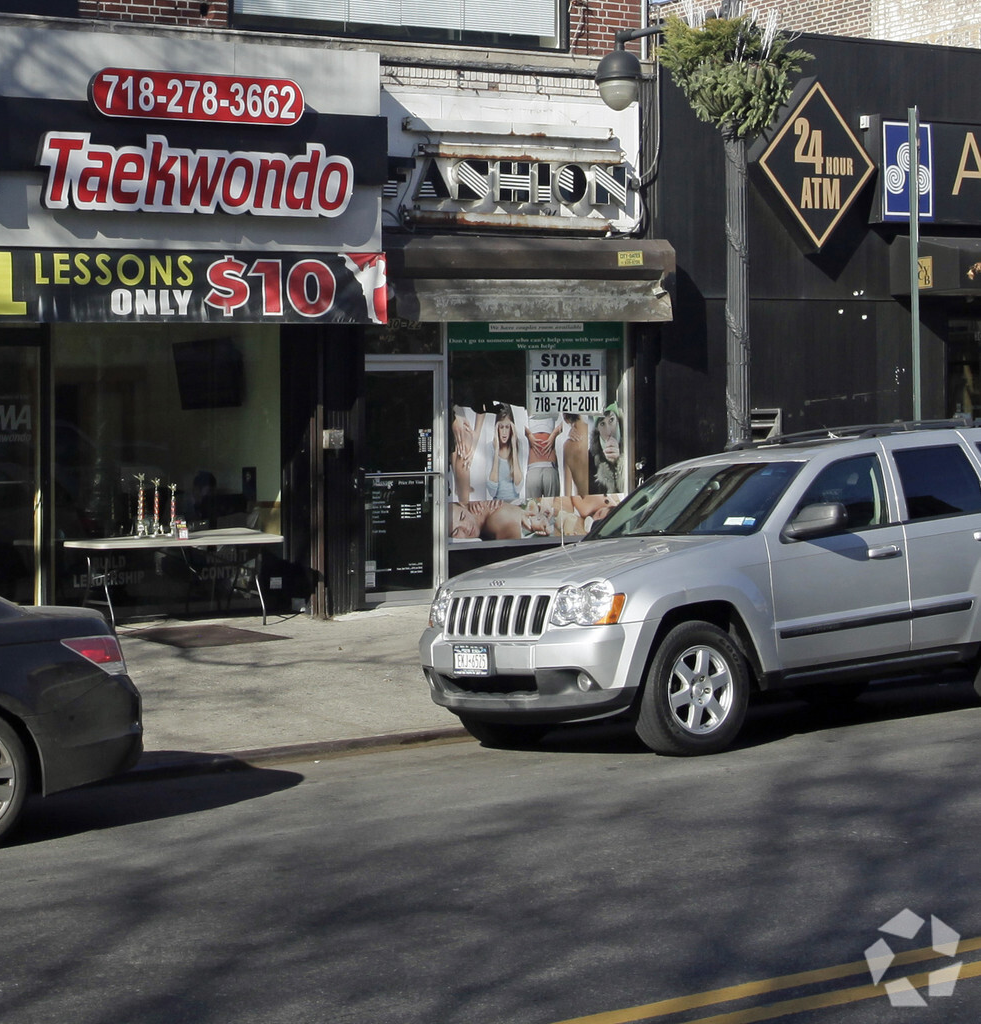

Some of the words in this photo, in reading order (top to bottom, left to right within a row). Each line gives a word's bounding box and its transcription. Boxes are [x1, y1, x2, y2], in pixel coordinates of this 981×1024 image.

[102, 73, 297, 120] 718-278-3662
[794, 117, 823, 176] 24
[825, 156, 854, 176] HOUR
[41, 132, 354, 217] Taekwondo
[800, 177, 841, 210] ATM
[34, 252, 194, 287] LESSONS
[204, 255, 337, 318] $10
[110, 288, 191, 316] ONLY
[540, 353, 592, 367] STORE
[532, 370, 558, 392] FOR
[563, 370, 600, 392] RENT
[534, 396, 599, 413] 718-721-2011
